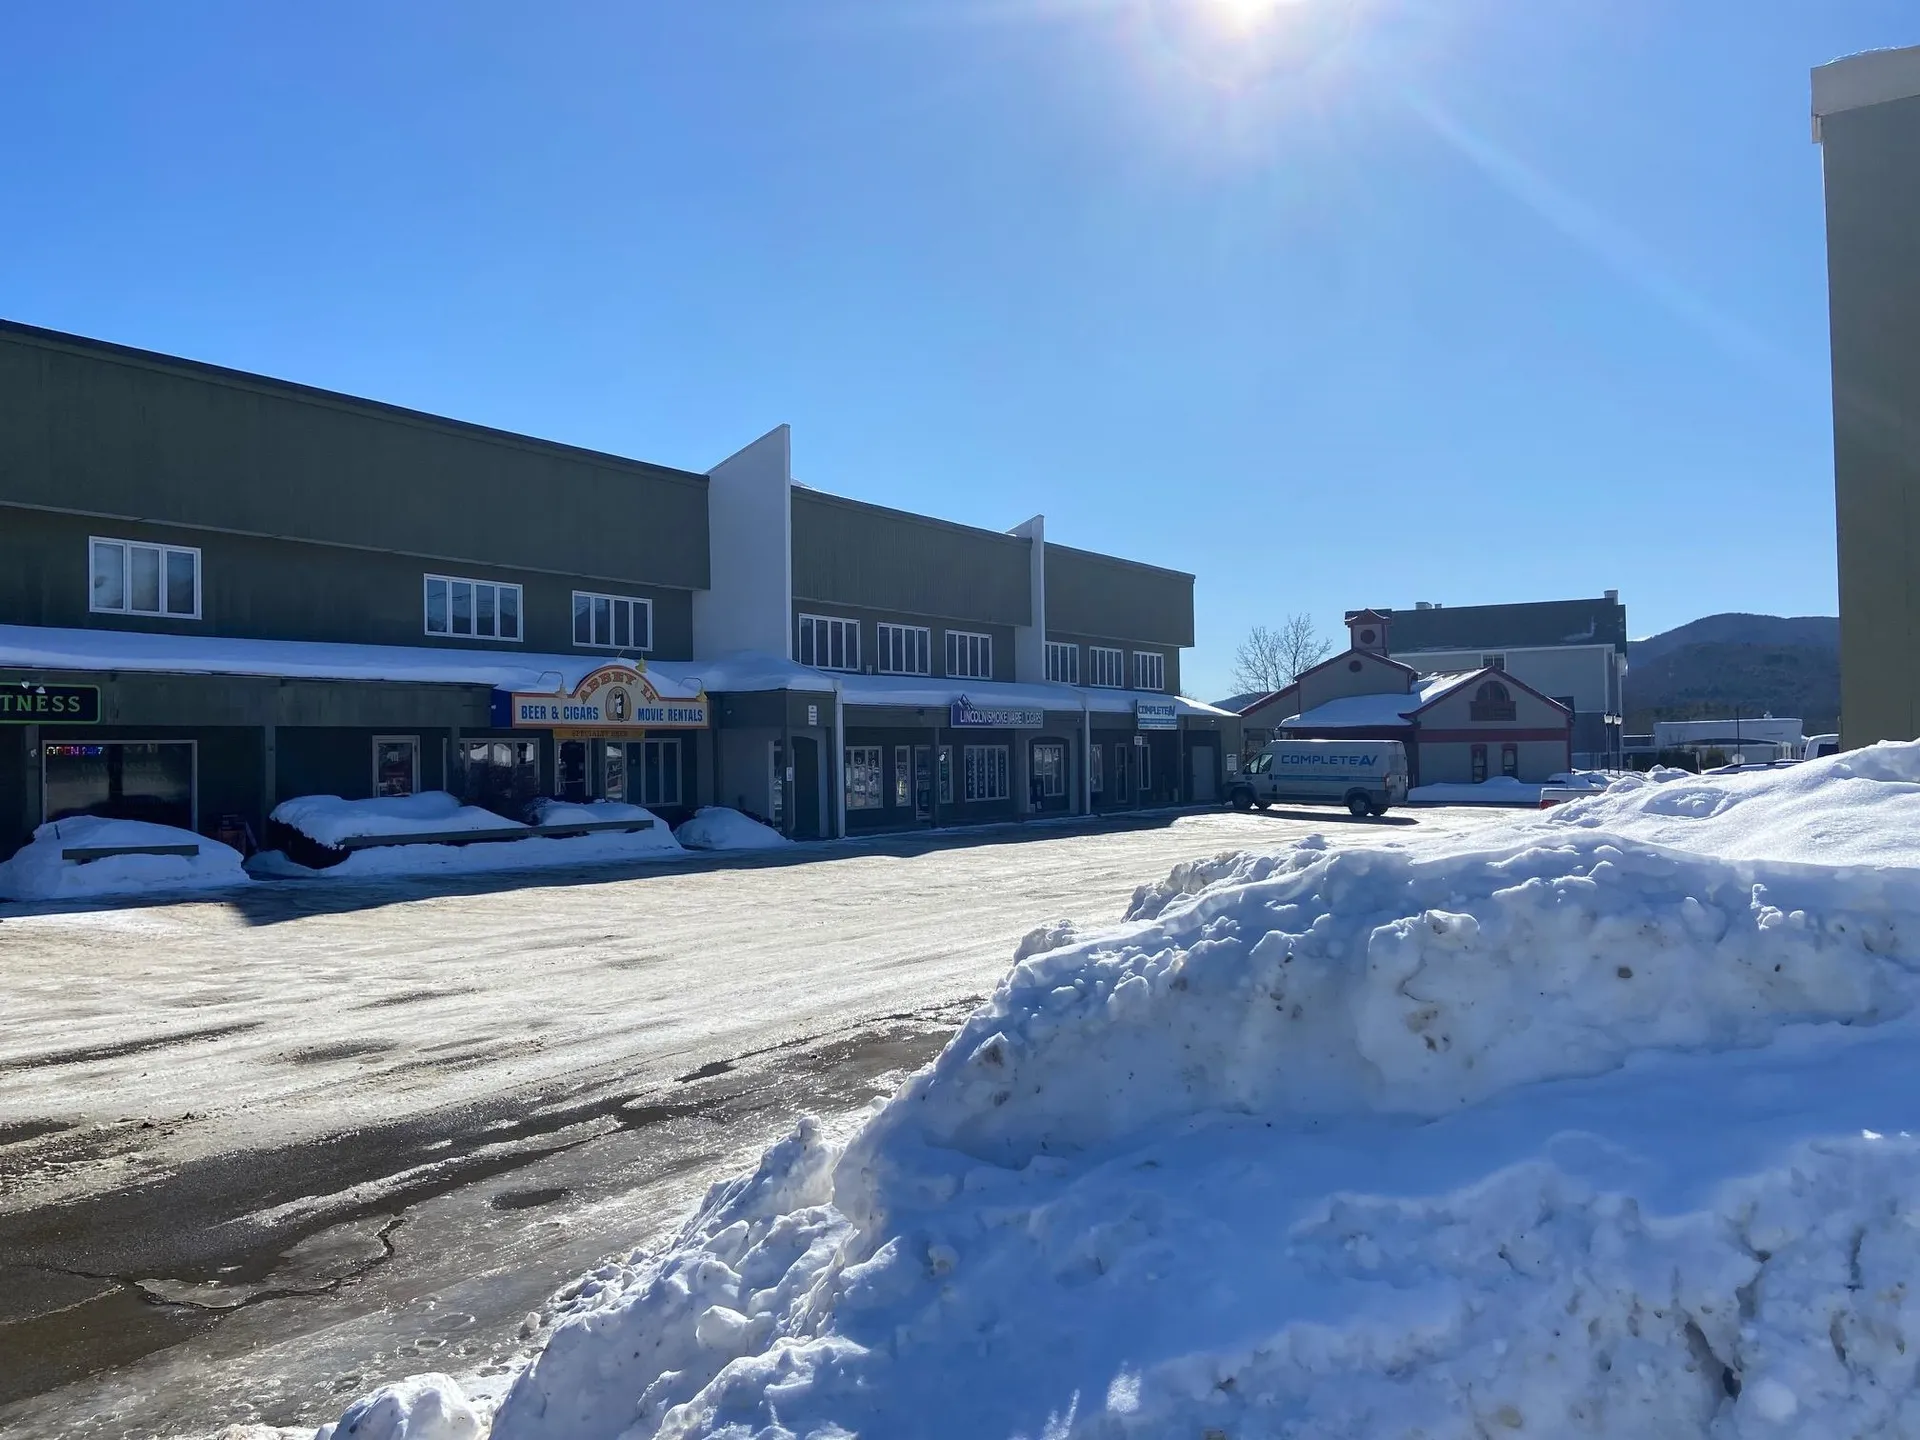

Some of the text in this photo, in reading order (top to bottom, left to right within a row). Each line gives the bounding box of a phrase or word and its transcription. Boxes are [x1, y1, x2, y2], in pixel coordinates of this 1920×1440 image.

[580, 671, 637, 705] ABBEY
[0, 694, 81, 712] TNESS
[521, 705, 599, 721] BEER & CIGARS
[637, 707, 703, 723] MOVIE RENTALS
[960, 710, 987, 723] LINCOLN
